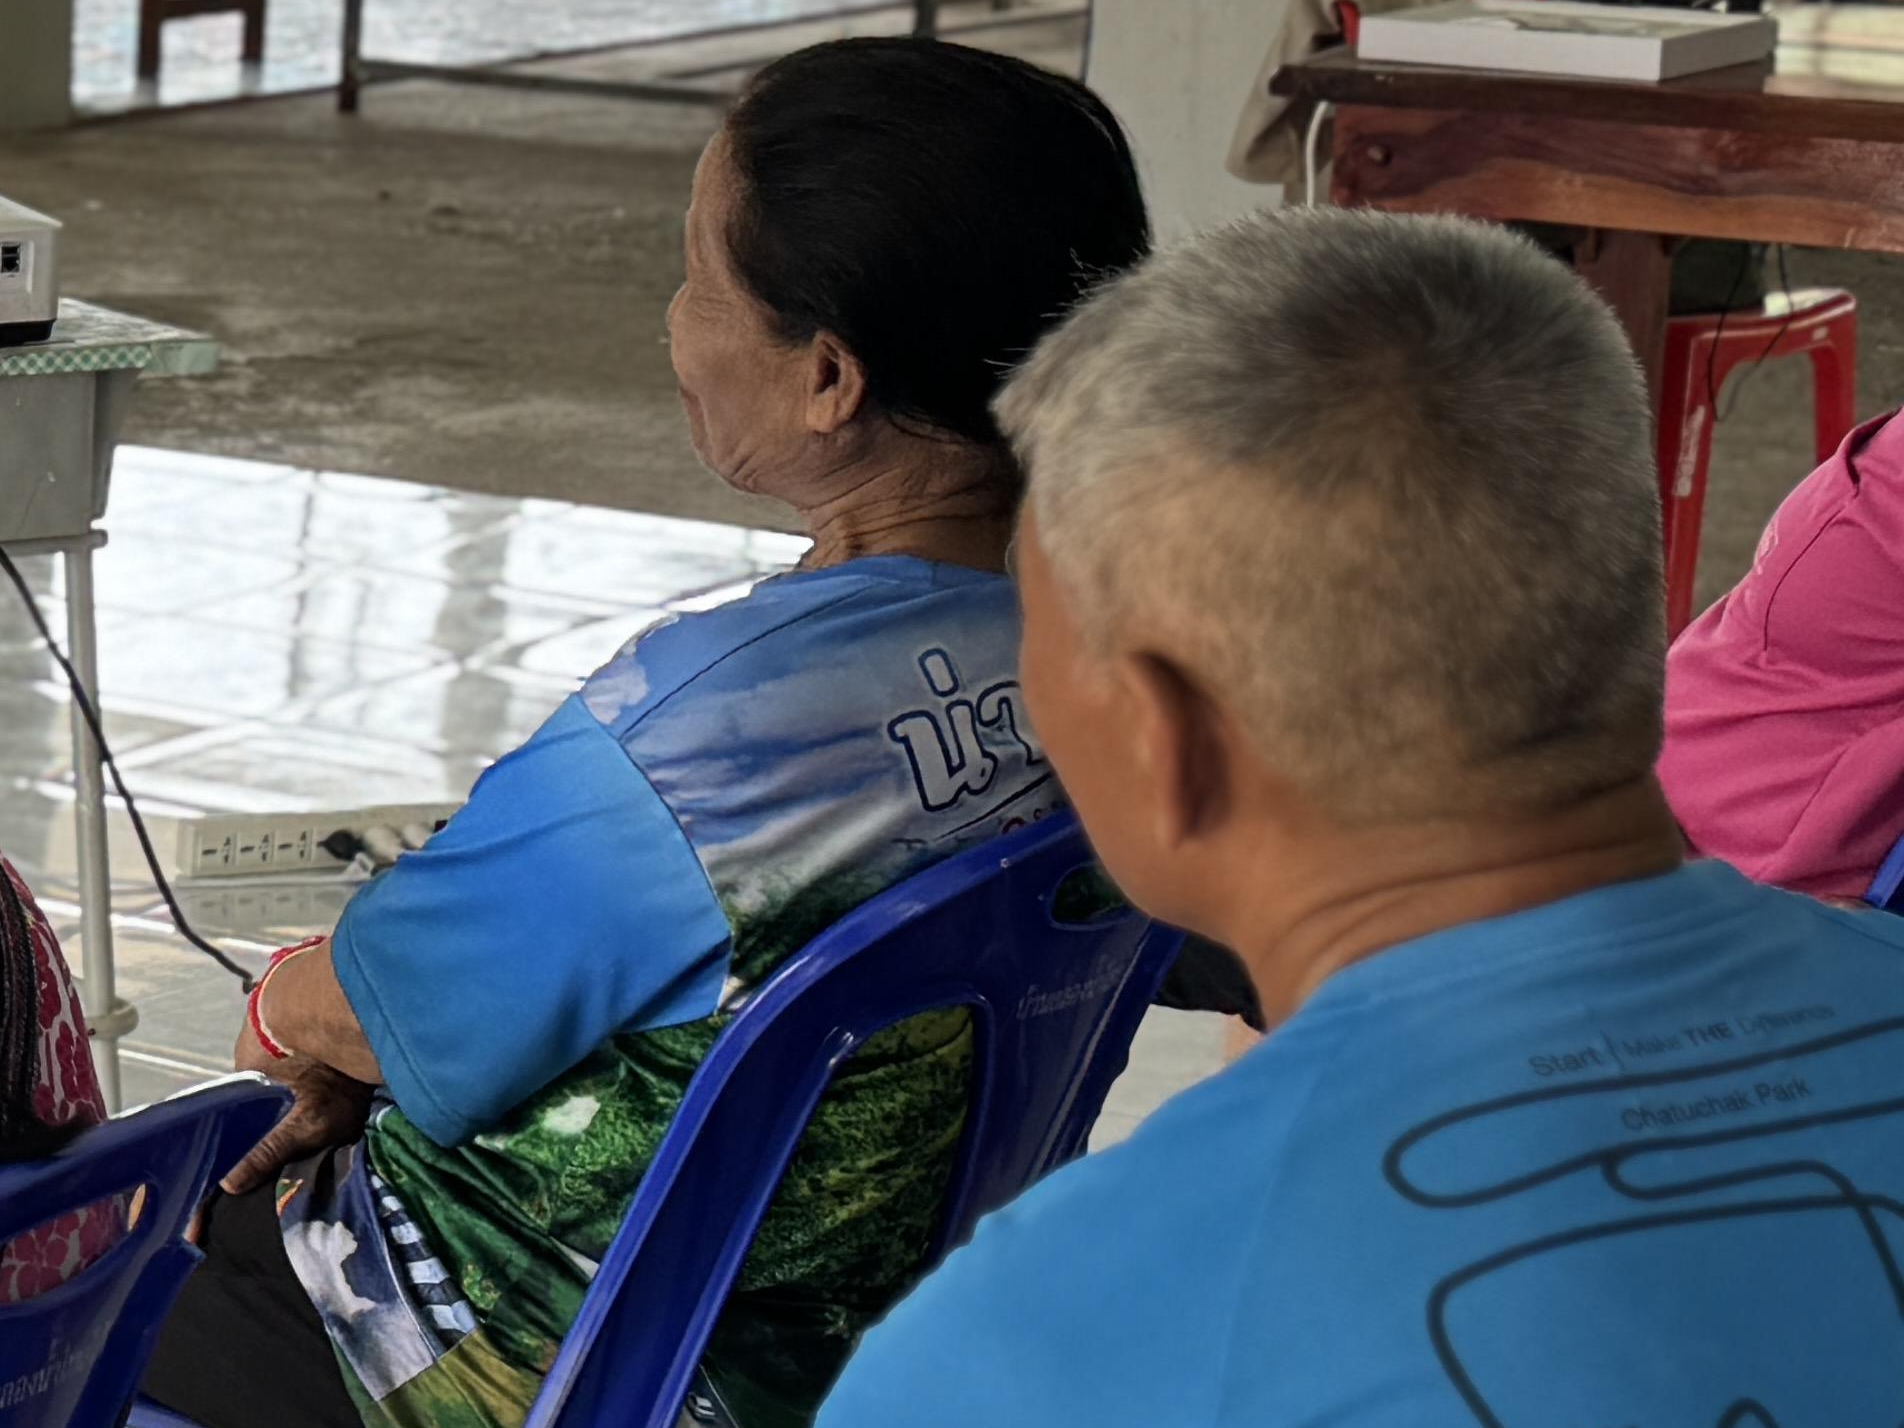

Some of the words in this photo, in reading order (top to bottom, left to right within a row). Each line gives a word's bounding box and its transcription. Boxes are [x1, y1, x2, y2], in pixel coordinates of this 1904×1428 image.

[1680, 1019, 1735, 1051] THE
[1527, 1043, 1605, 1078] Start
[1619, 1084, 1755, 1132] Chatuchak
[1754, 1078, 1812, 1106] Park
